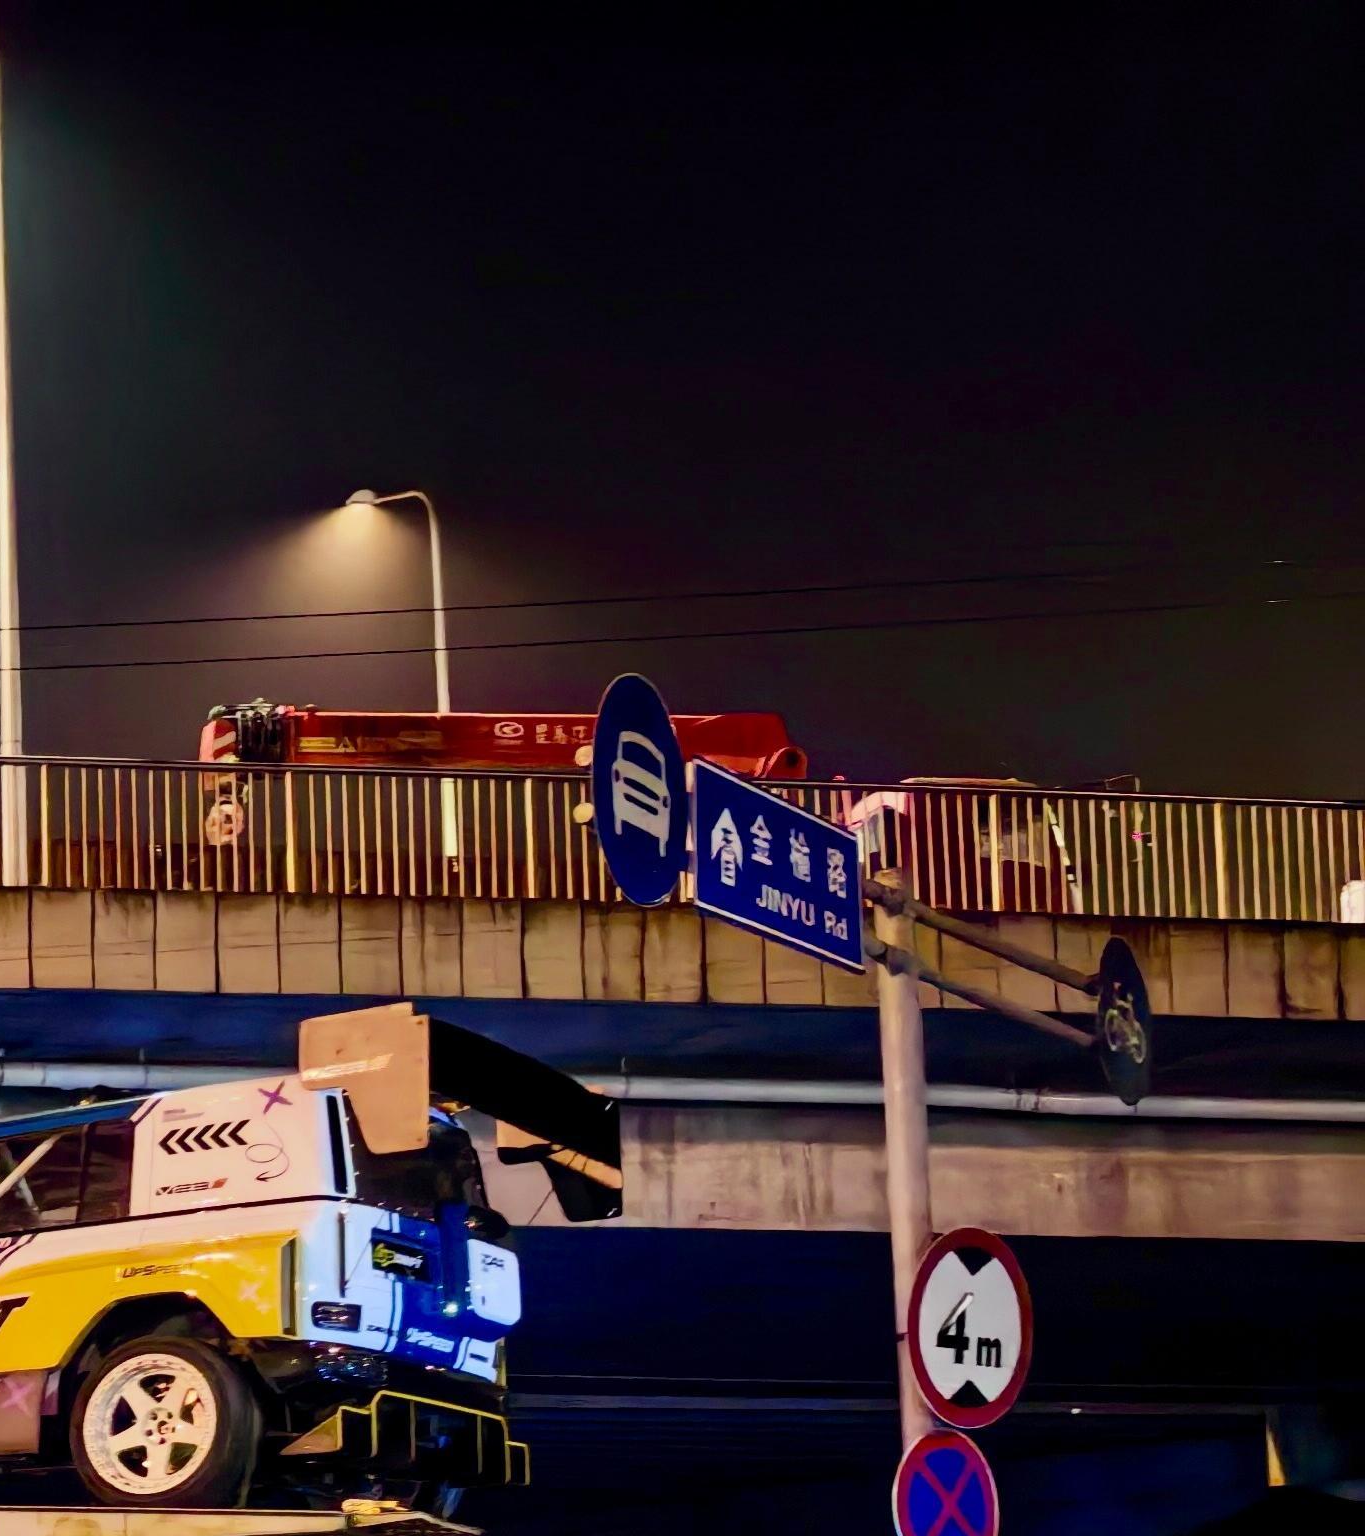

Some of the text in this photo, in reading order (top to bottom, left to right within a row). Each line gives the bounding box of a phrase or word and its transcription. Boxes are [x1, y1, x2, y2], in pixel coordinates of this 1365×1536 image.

[756, 884, 848, 940] JINYU Rd
[936, 1292, 1002, 1368] 4m
